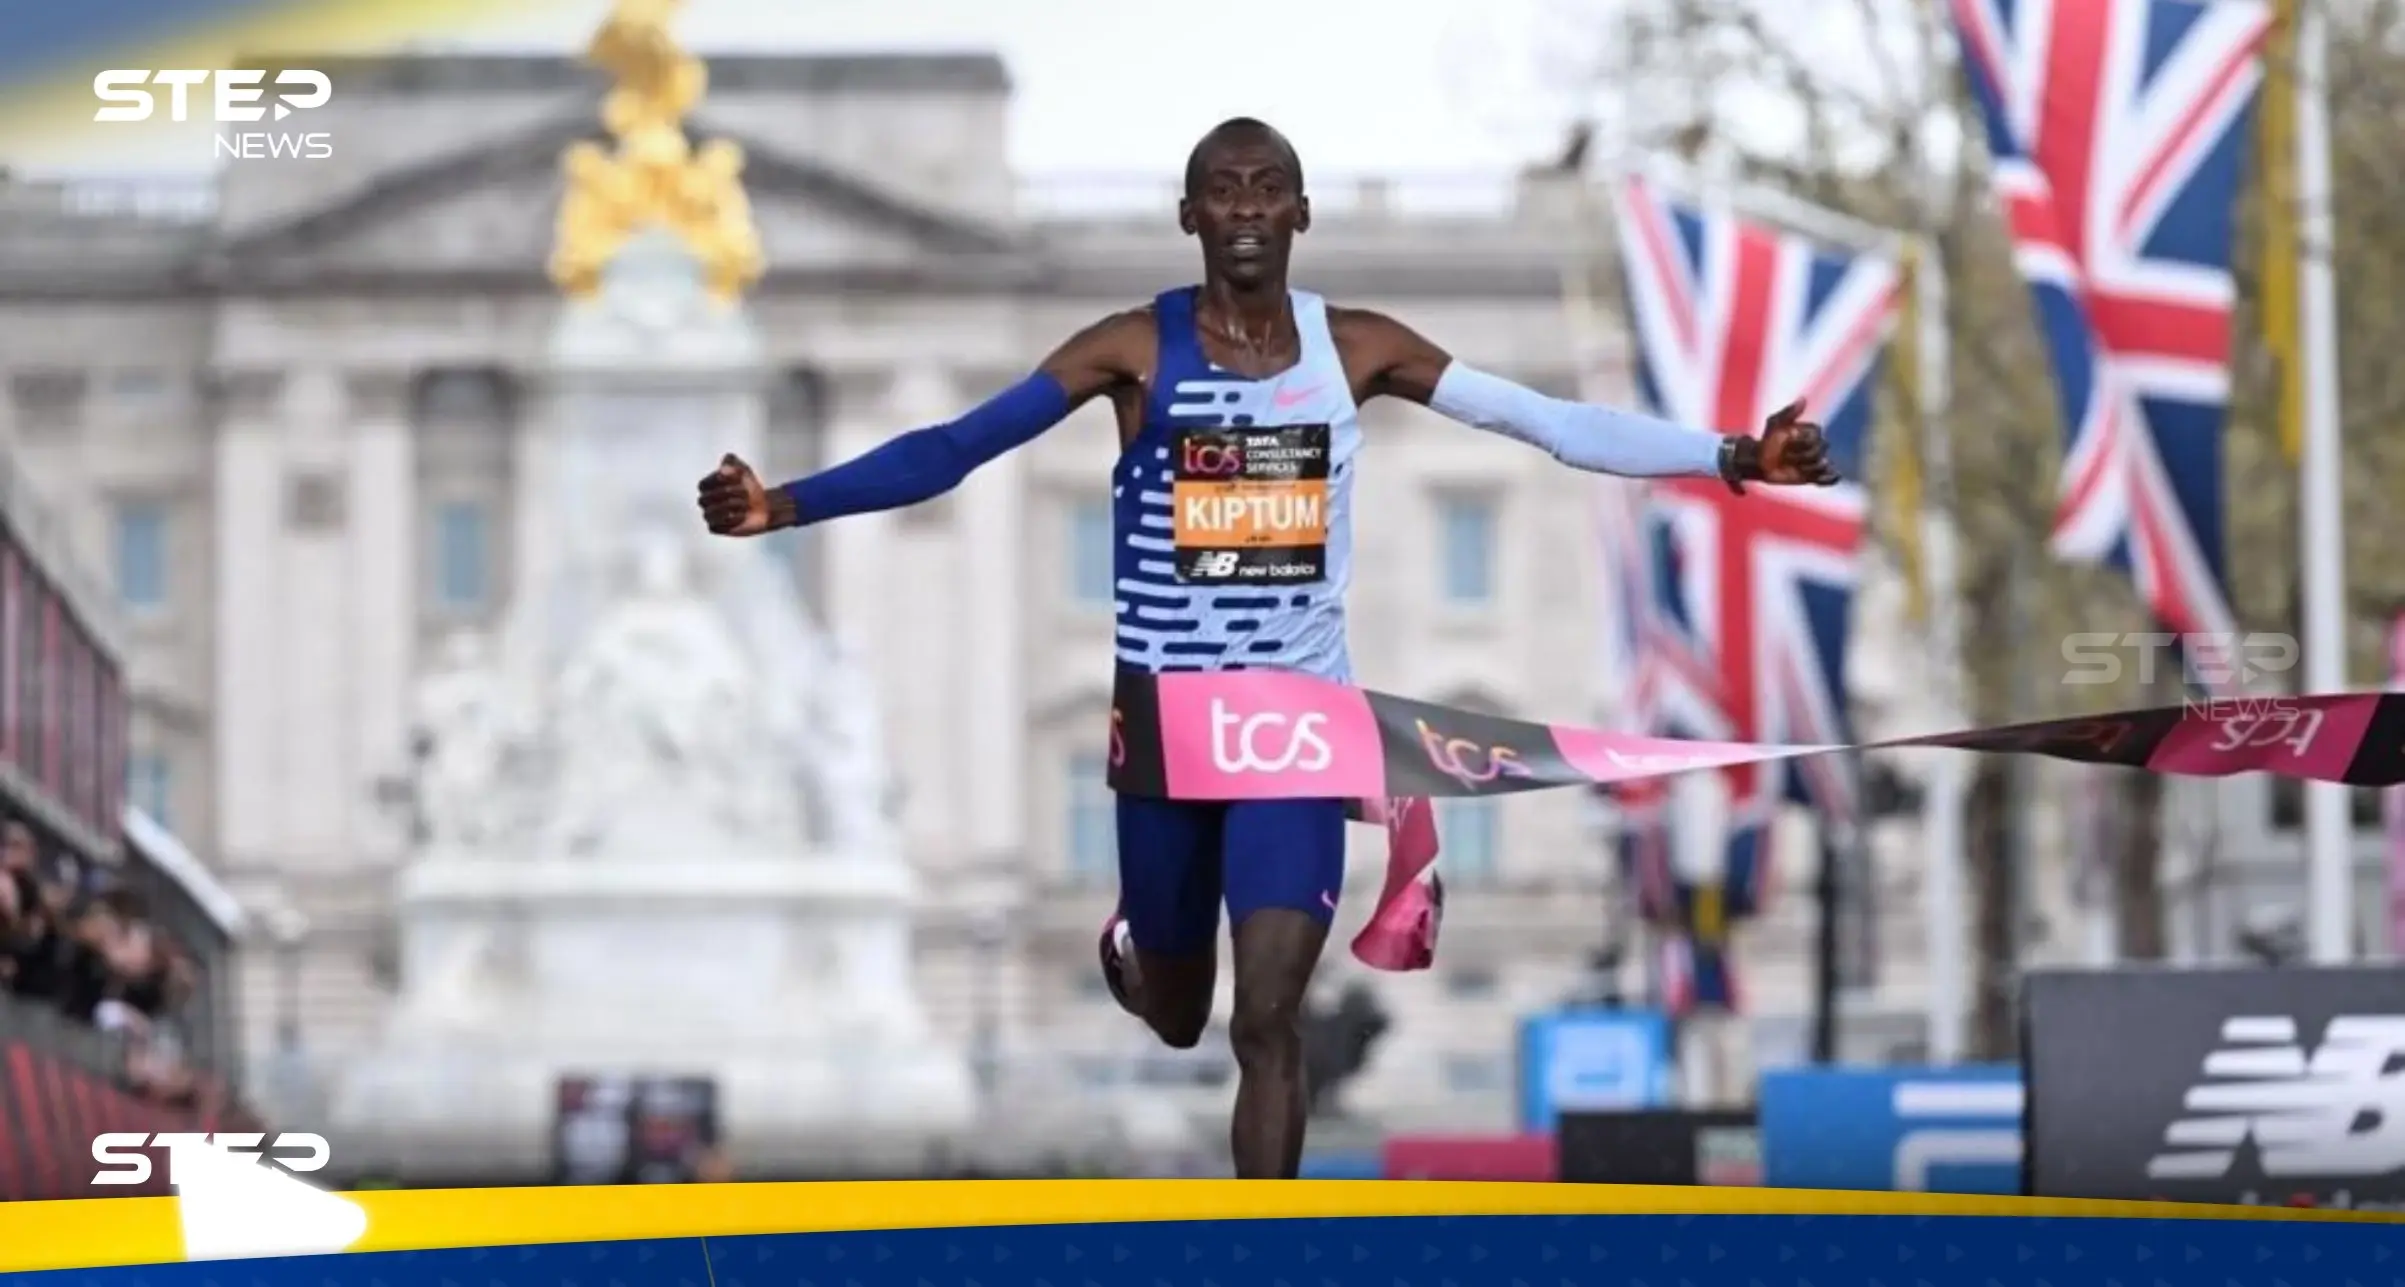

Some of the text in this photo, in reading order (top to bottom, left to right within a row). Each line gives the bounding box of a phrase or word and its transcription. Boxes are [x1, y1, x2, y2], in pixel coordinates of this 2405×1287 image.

[1184, 437, 1241, 474] tcs
[1246, 448, 1322, 460] CONSULTANCY
[1185, 495, 1320, 532] KIPTUM
[1239, 566, 1267, 577] new
[1210, 697, 1332, 774] tcs
[1415, 717, 1532, 785] tcs
